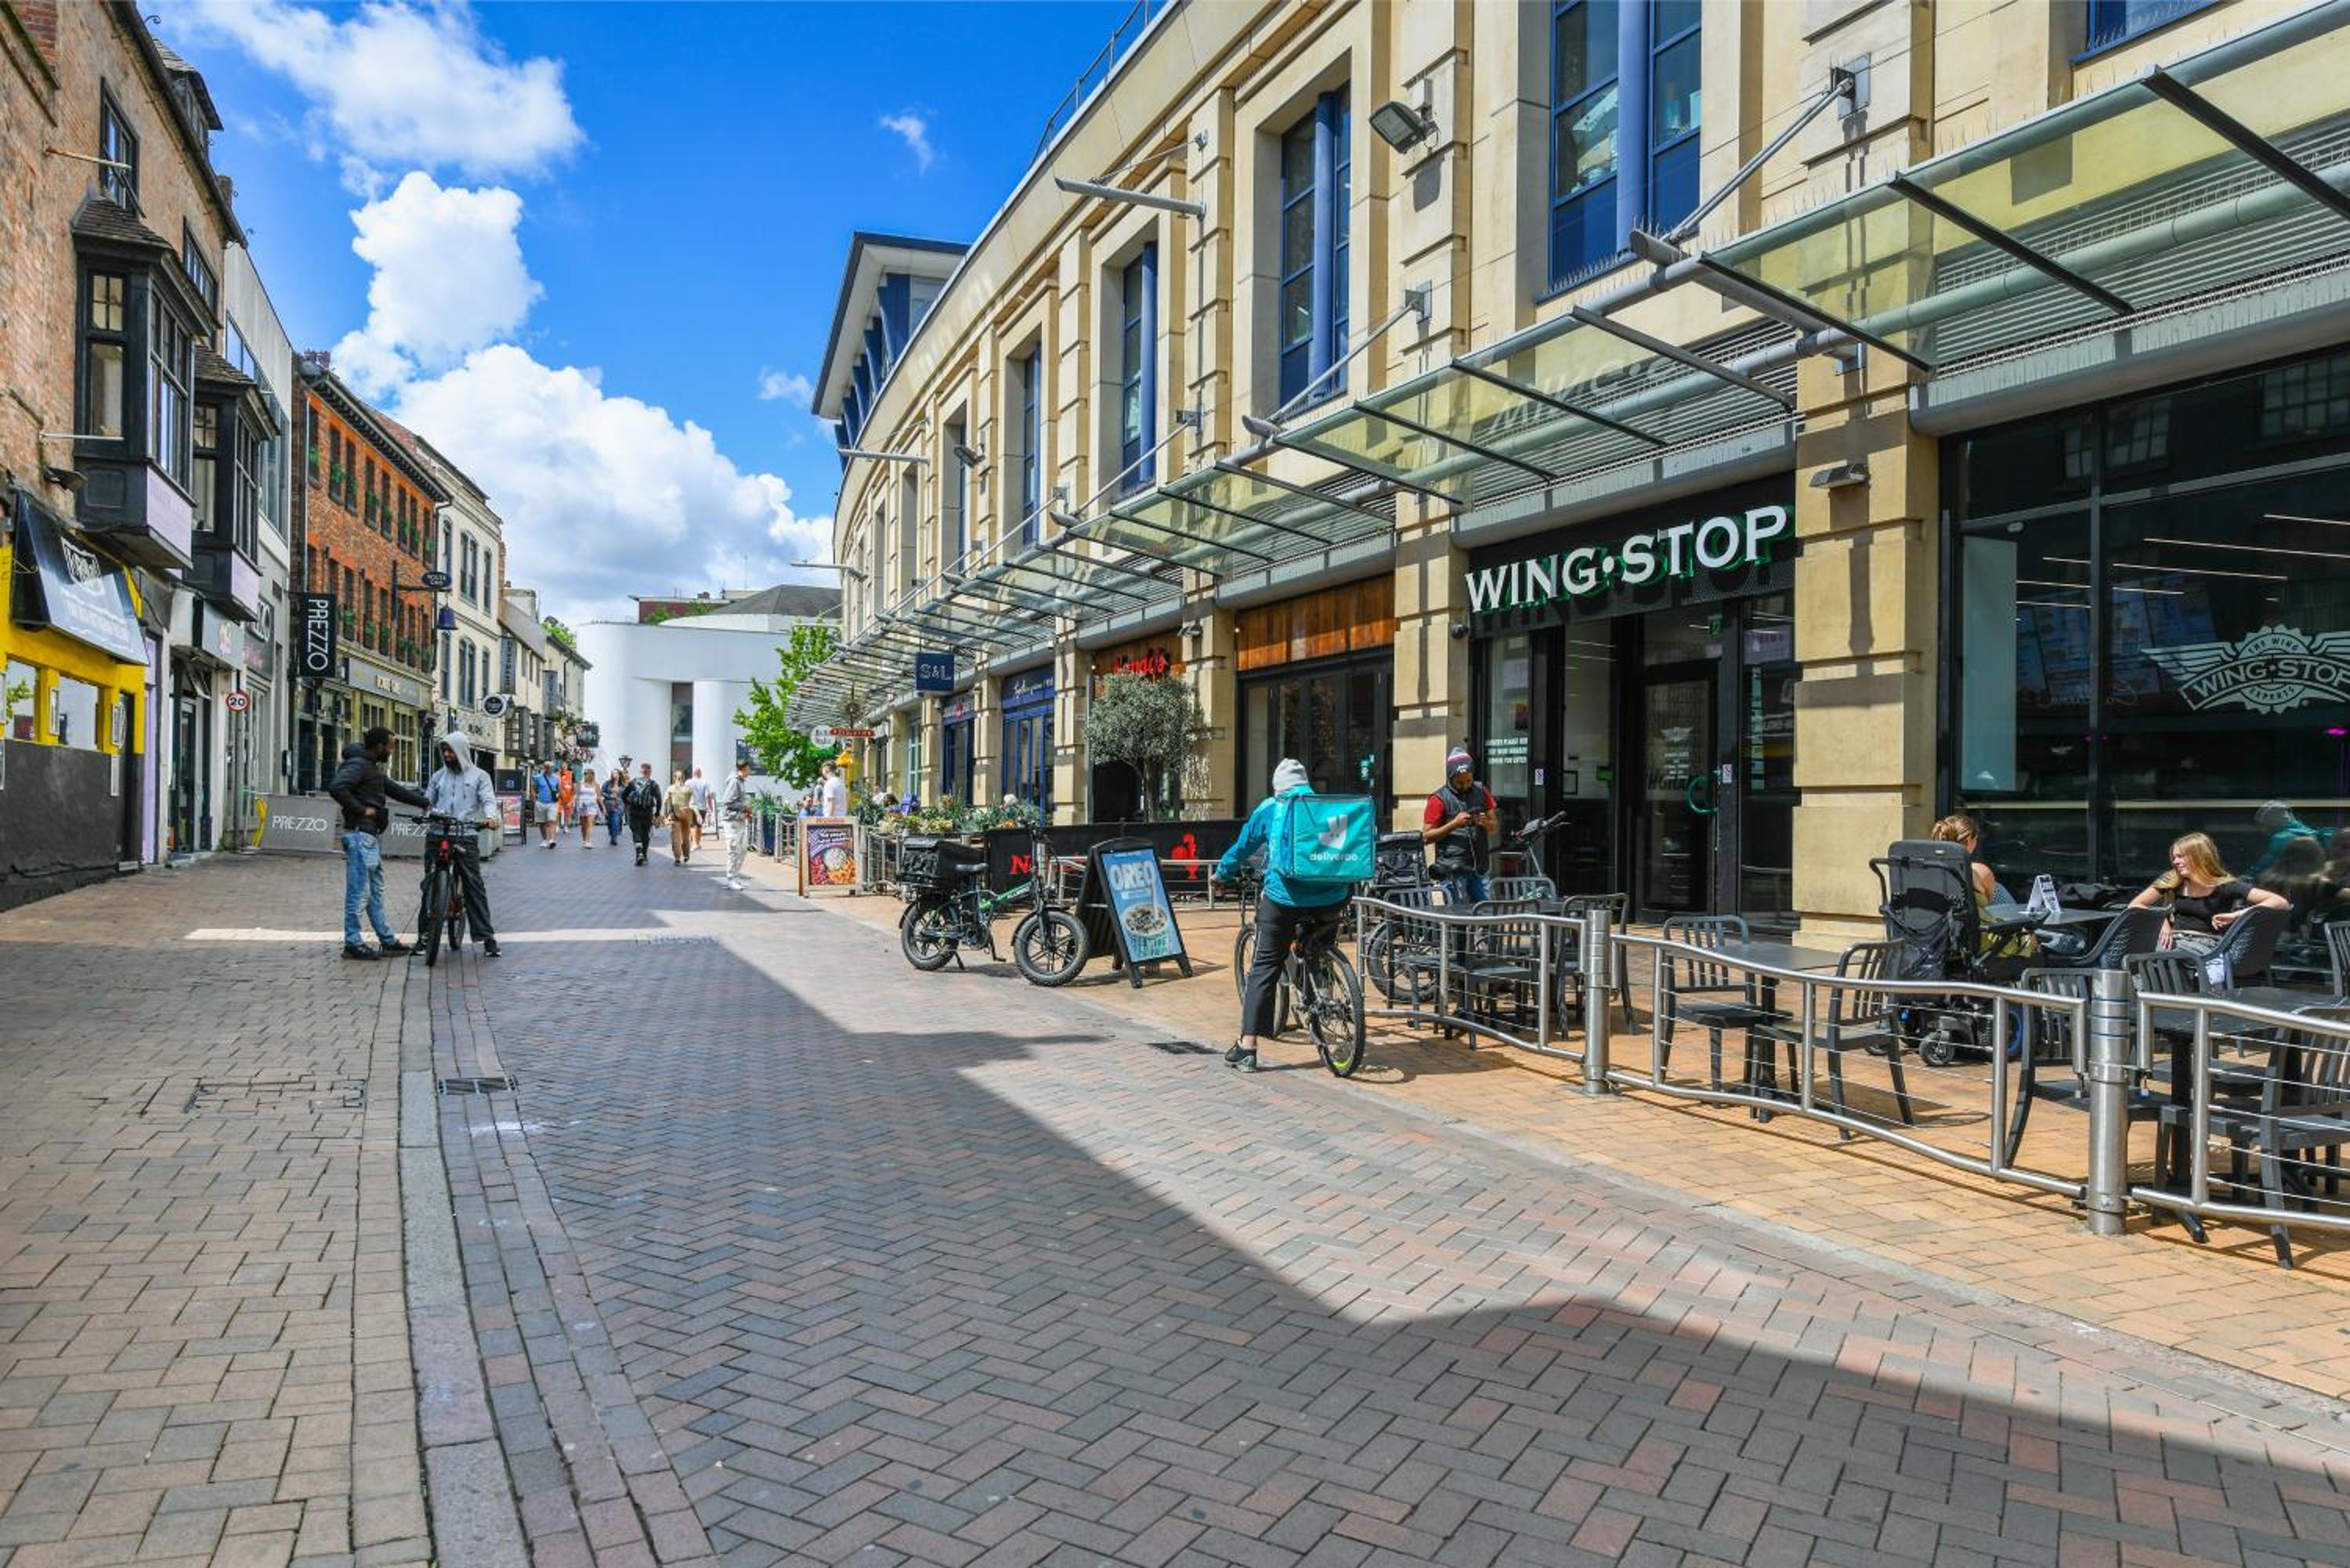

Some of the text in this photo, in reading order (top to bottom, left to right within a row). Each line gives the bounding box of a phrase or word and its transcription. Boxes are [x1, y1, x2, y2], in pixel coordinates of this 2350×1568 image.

[307, 598, 329, 672] PREZZO
[2248, 637, 2299, 655] THE WING
[2249, 685, 2295, 701] EXPERTS
[230, 697, 245, 706] 20
[272, 815, 327, 832] PREZZO
[391, 822, 427, 838] PREZZ
[1310, 851, 1358, 862] deliveroo
